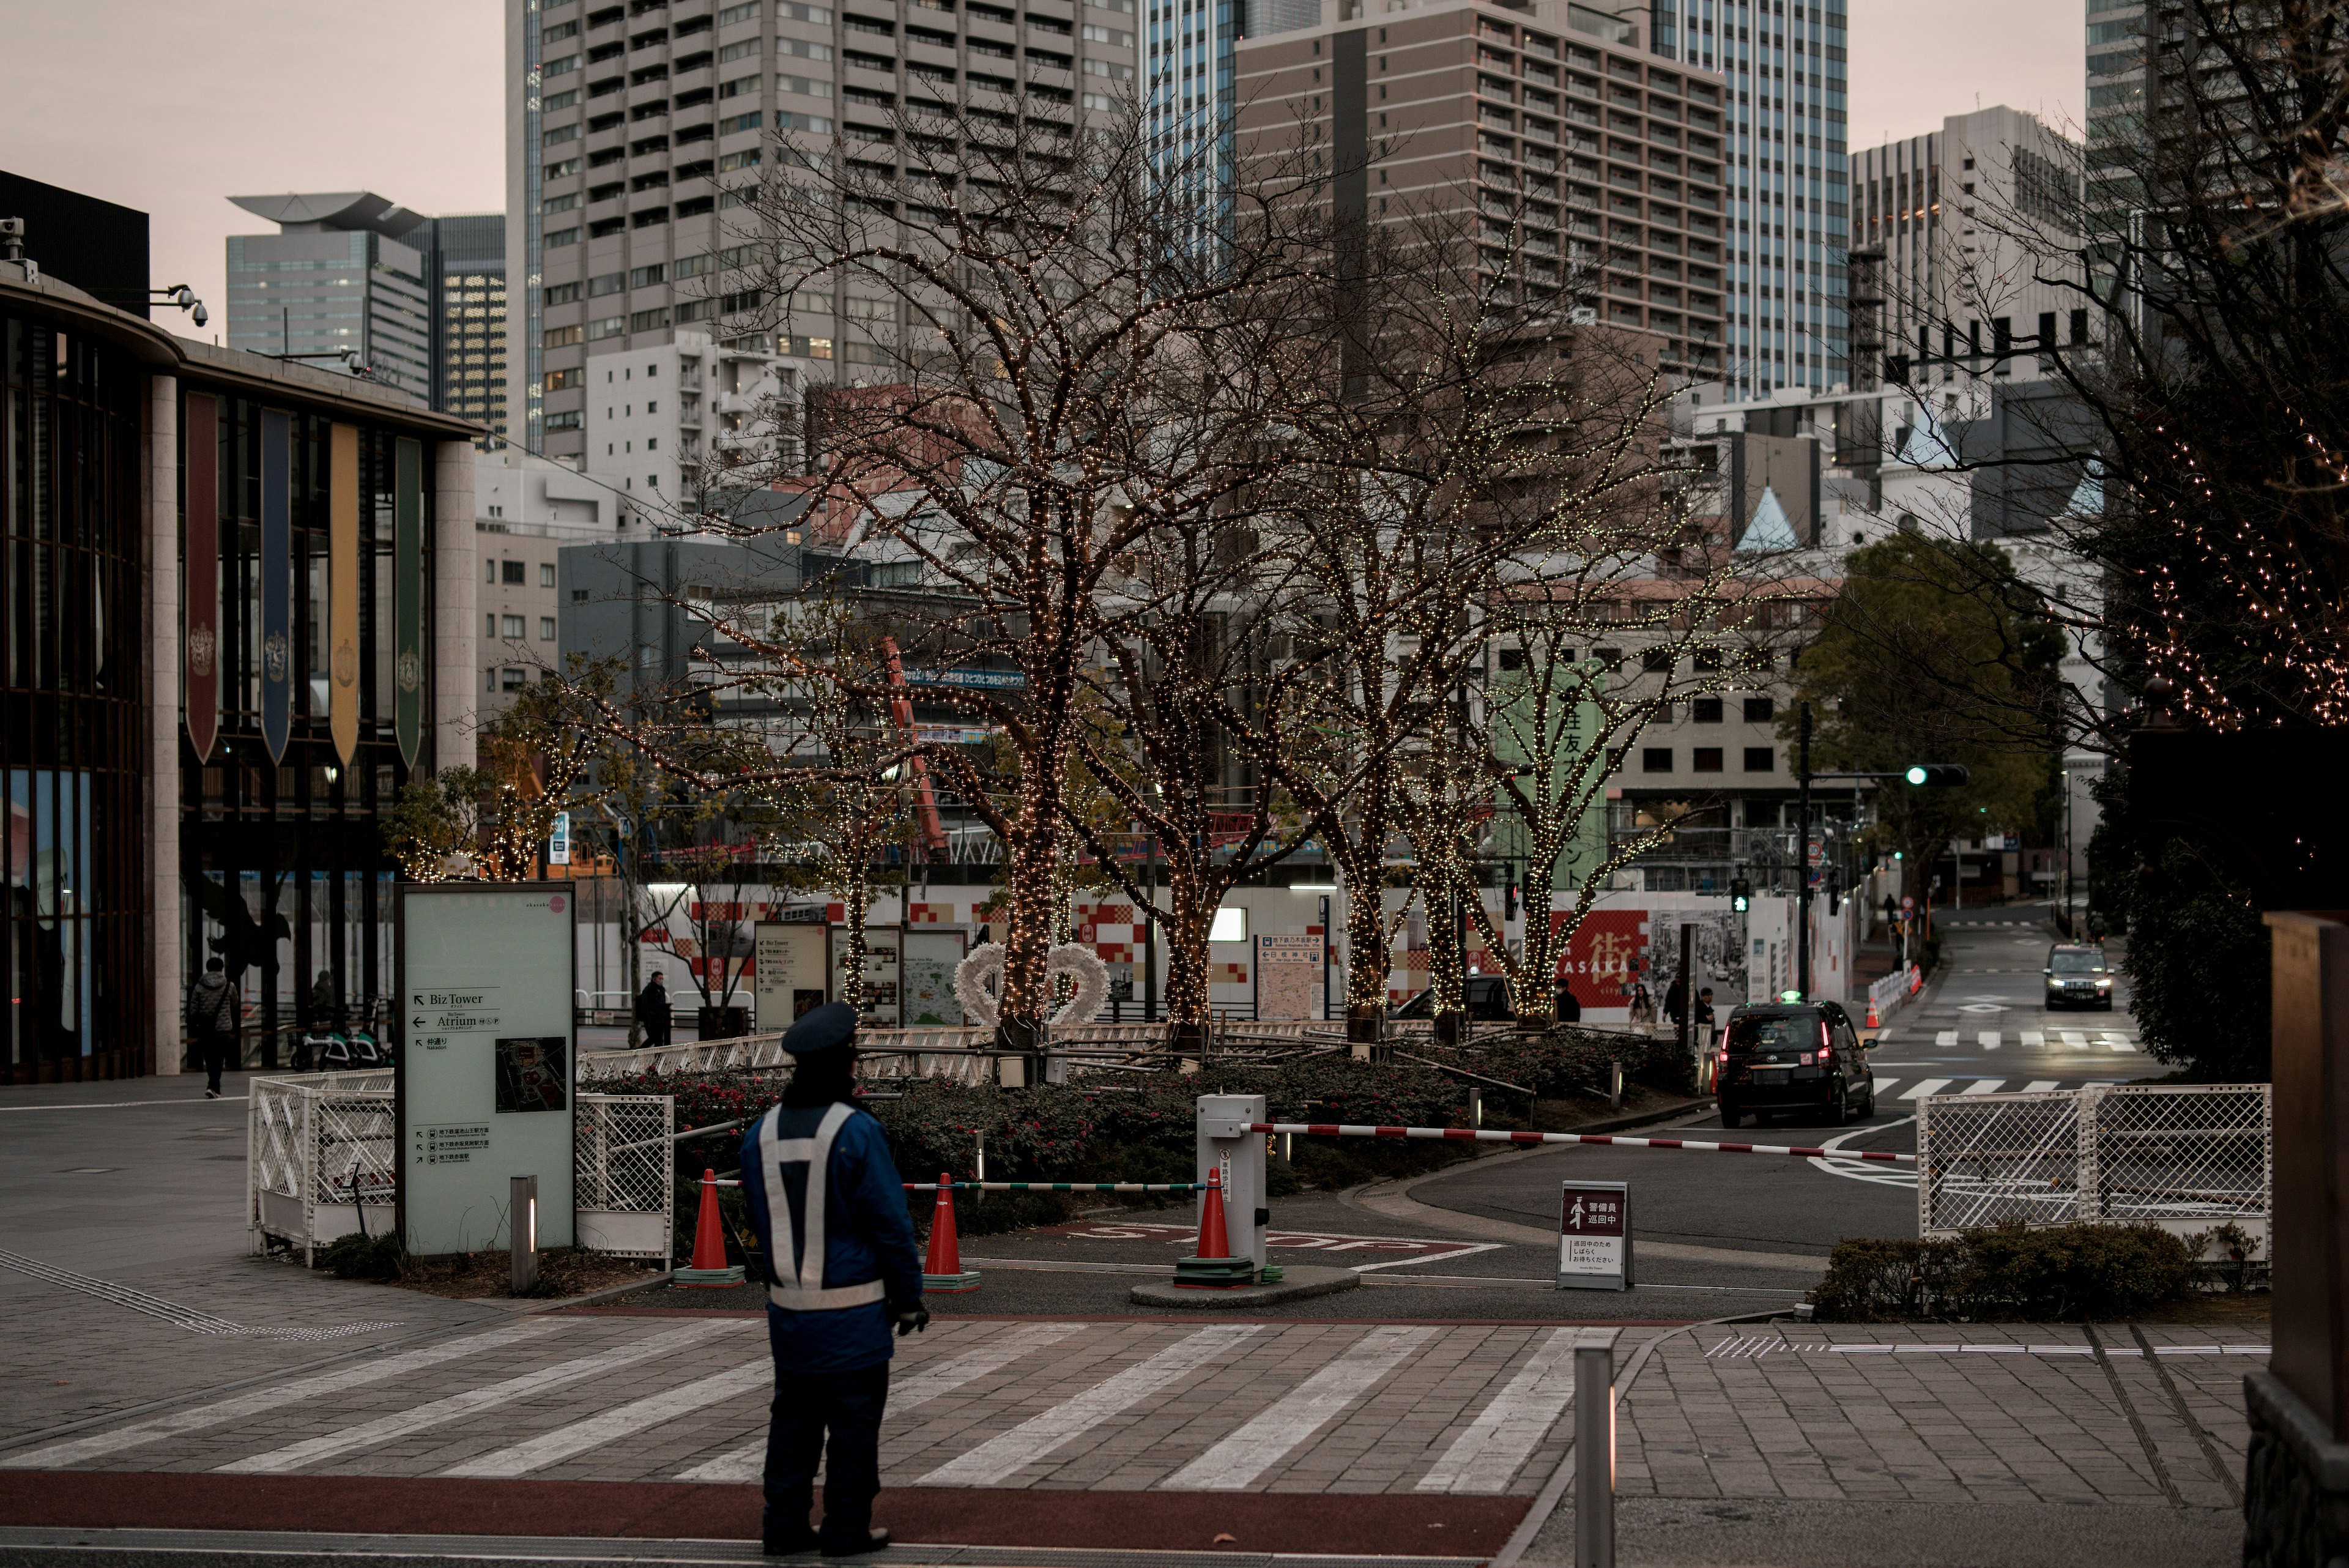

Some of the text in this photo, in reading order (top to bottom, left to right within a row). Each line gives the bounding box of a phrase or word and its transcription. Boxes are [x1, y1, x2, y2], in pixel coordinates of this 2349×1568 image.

[1564, 712, 1581, 887] 住友大メント
[1587, 932, 1632, 985] 街
[1552, 960, 1628, 974] KASAKA
[1600, 986, 1620, 996] city
[430, 994, 483, 1005] Biz Tower
[437, 1016, 477, 1026] Atrium
[1589, 1202, 1617, 1213] 警備員
[1588, 1214, 1616, 1224] 巡回中
